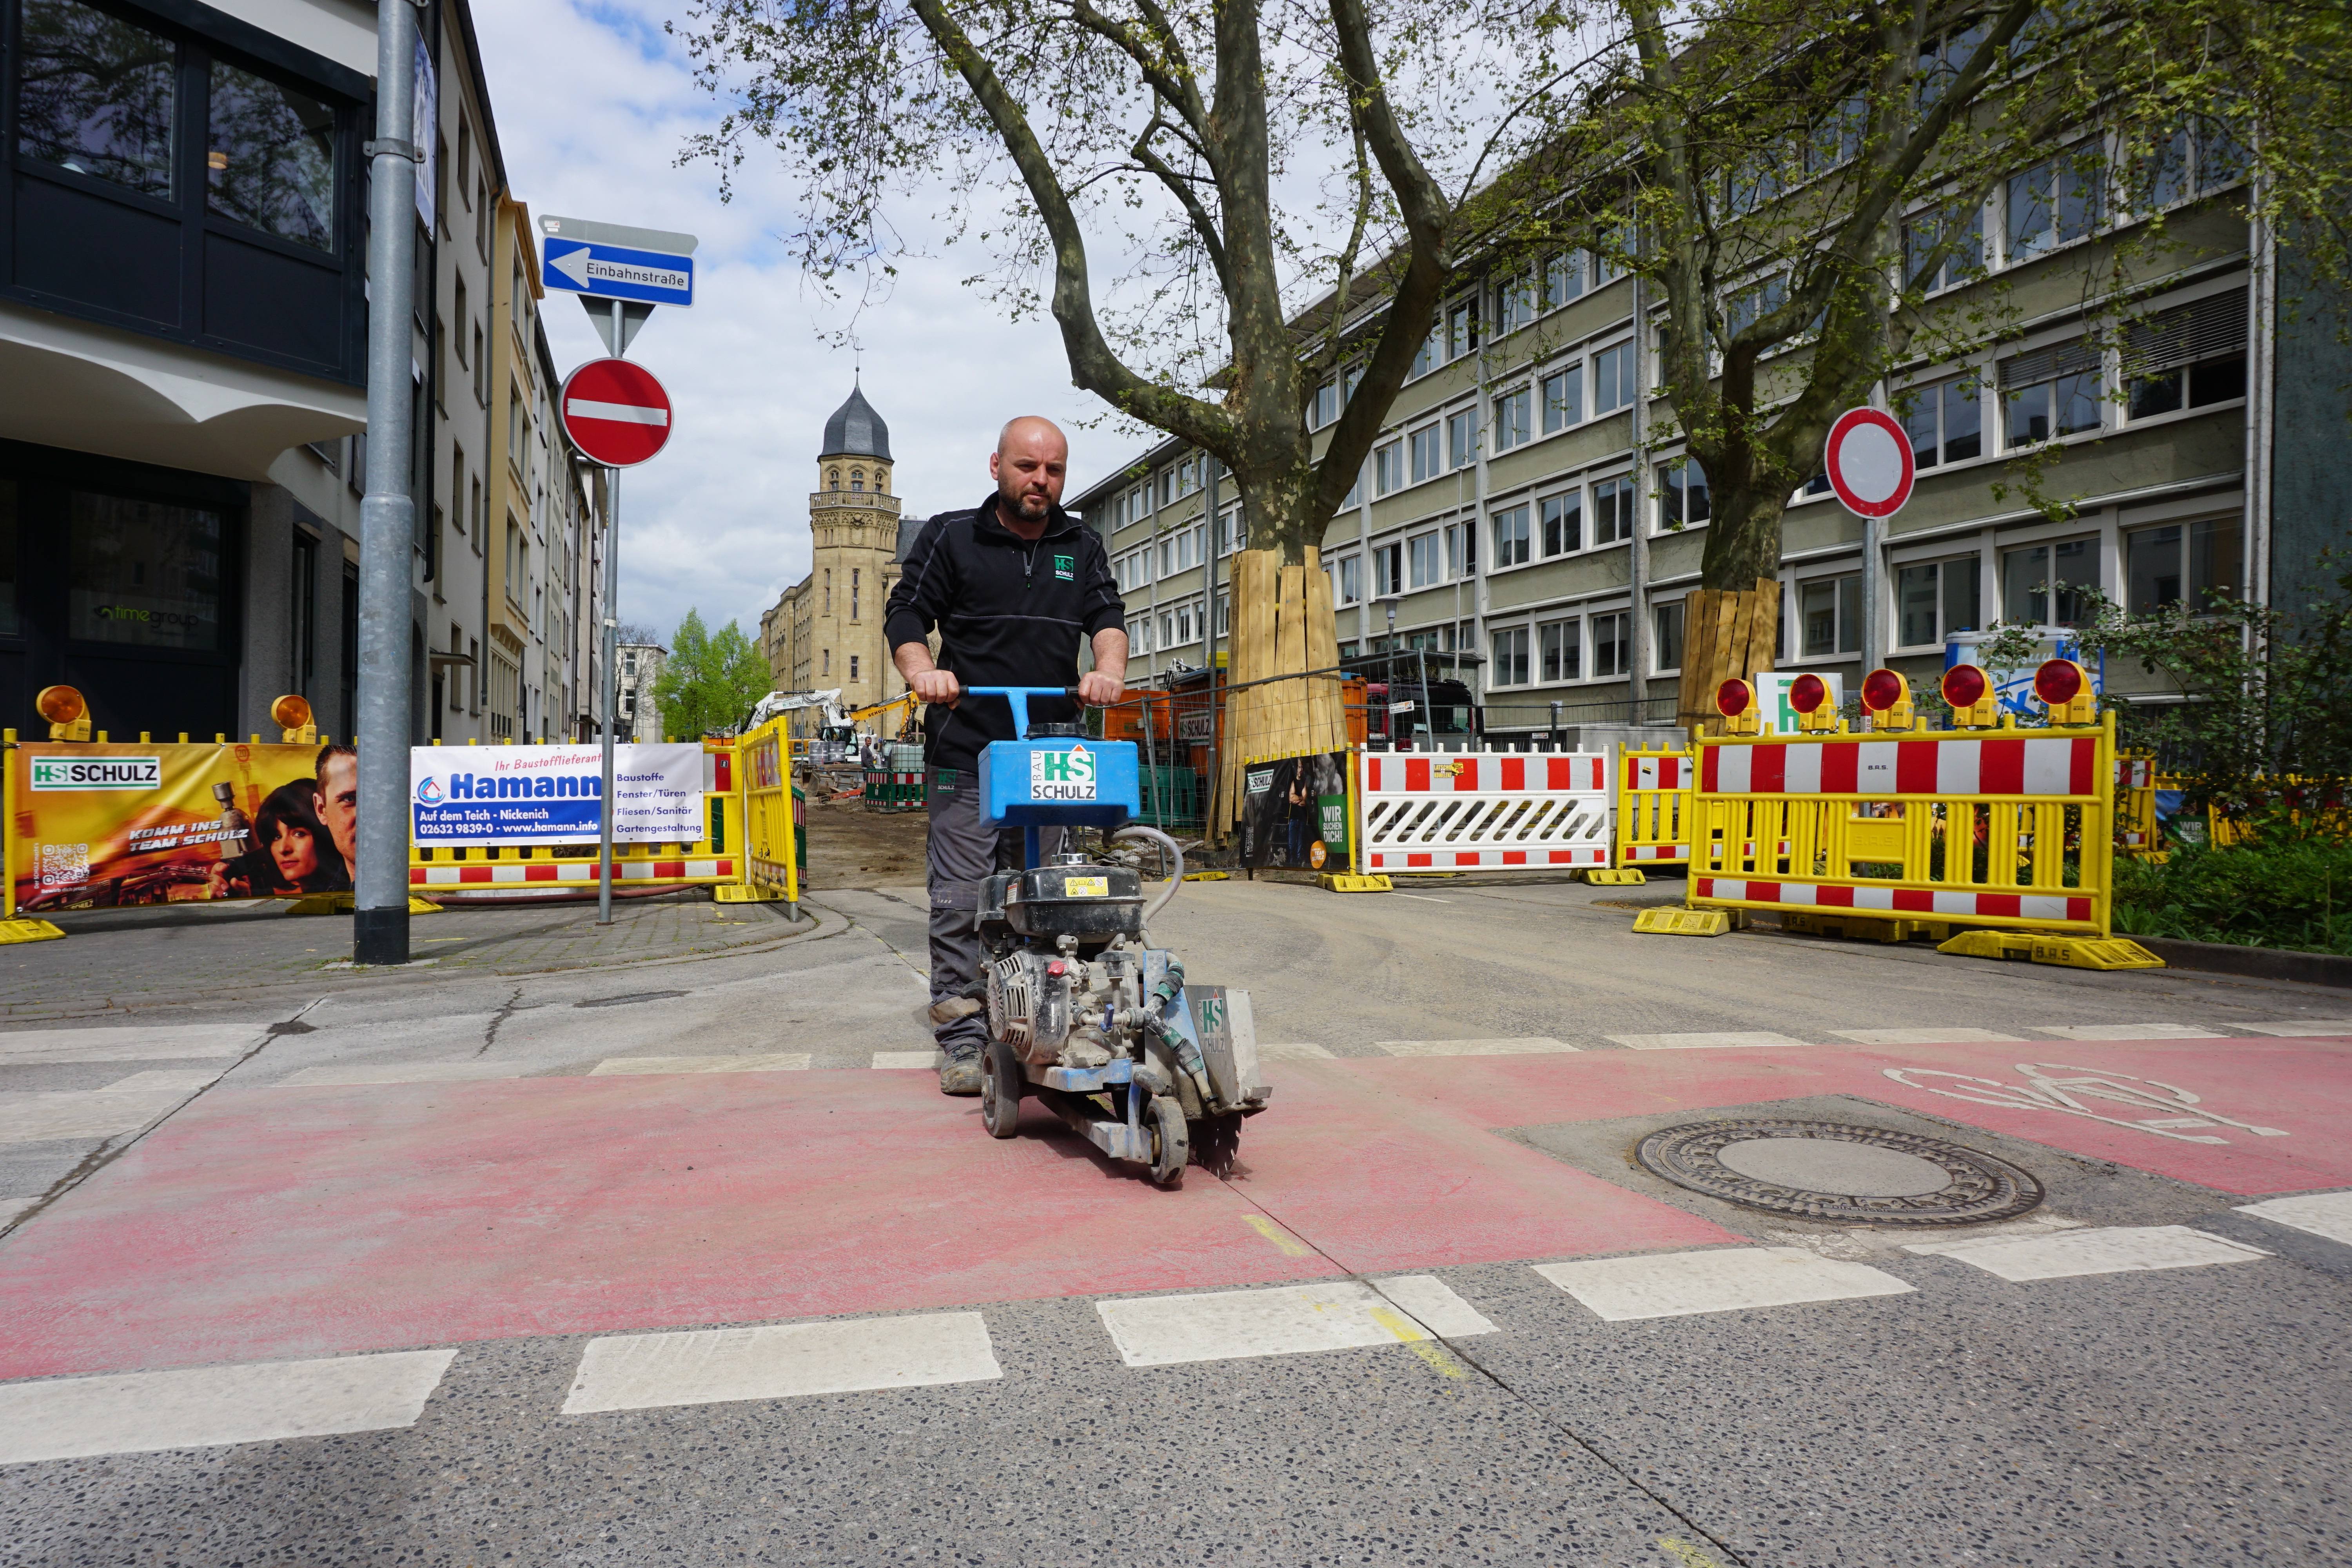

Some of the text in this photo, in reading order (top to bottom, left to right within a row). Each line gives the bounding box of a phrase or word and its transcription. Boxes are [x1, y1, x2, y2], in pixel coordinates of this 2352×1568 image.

[587, 263, 684, 286] Einbahnstraße
[1055, 558, 1073, 572] HS
[115, 605, 199, 630] timegroup
[868, 708, 887, 717] SCHULZ
[1188, 719, 1209, 737] SCHULZ
[495, 753, 602, 771] Ihr Baustofflieferant
[1033, 752, 1041, 780] BAU
[1045, 752, 1094, 781] HS
[34, 765, 157, 782] HS SCHULZ
[617, 773, 664, 781] Baustoffe
[450, 773, 602, 799] Hamann
[1253, 775, 1272, 788] SCHULZ
[617, 789, 686, 798] Fenster/Türen
[1033, 785, 1095, 799] SCHULZ
[419, 811, 437, 821] Auf
[440, 810, 462, 821] dem
[465, 809, 490, 820] Teich
[500, 808, 548, 820] Nickenich
[617, 806, 692, 815] Fliesen/Sanitär
[1323, 806, 1341, 822] WIR
[129, 820, 222, 840] KOMM INS
[420, 824, 453, 834] 02632
[456, 823, 493, 833] 9839-0
[503, 820, 598, 833] www.hamann.info
[617, 823, 701, 834] Gartengestaltung
[1323, 822, 1342, 830] SUCHEN
[2180, 821, 2202, 831] WIR
[129, 829, 249, 851] TEAM SCHULZ
[1323, 830, 1342, 842] DICH!
[2036, 946, 2073, 962] B.A.S.
[1203, 1000, 1223, 1033] HS
